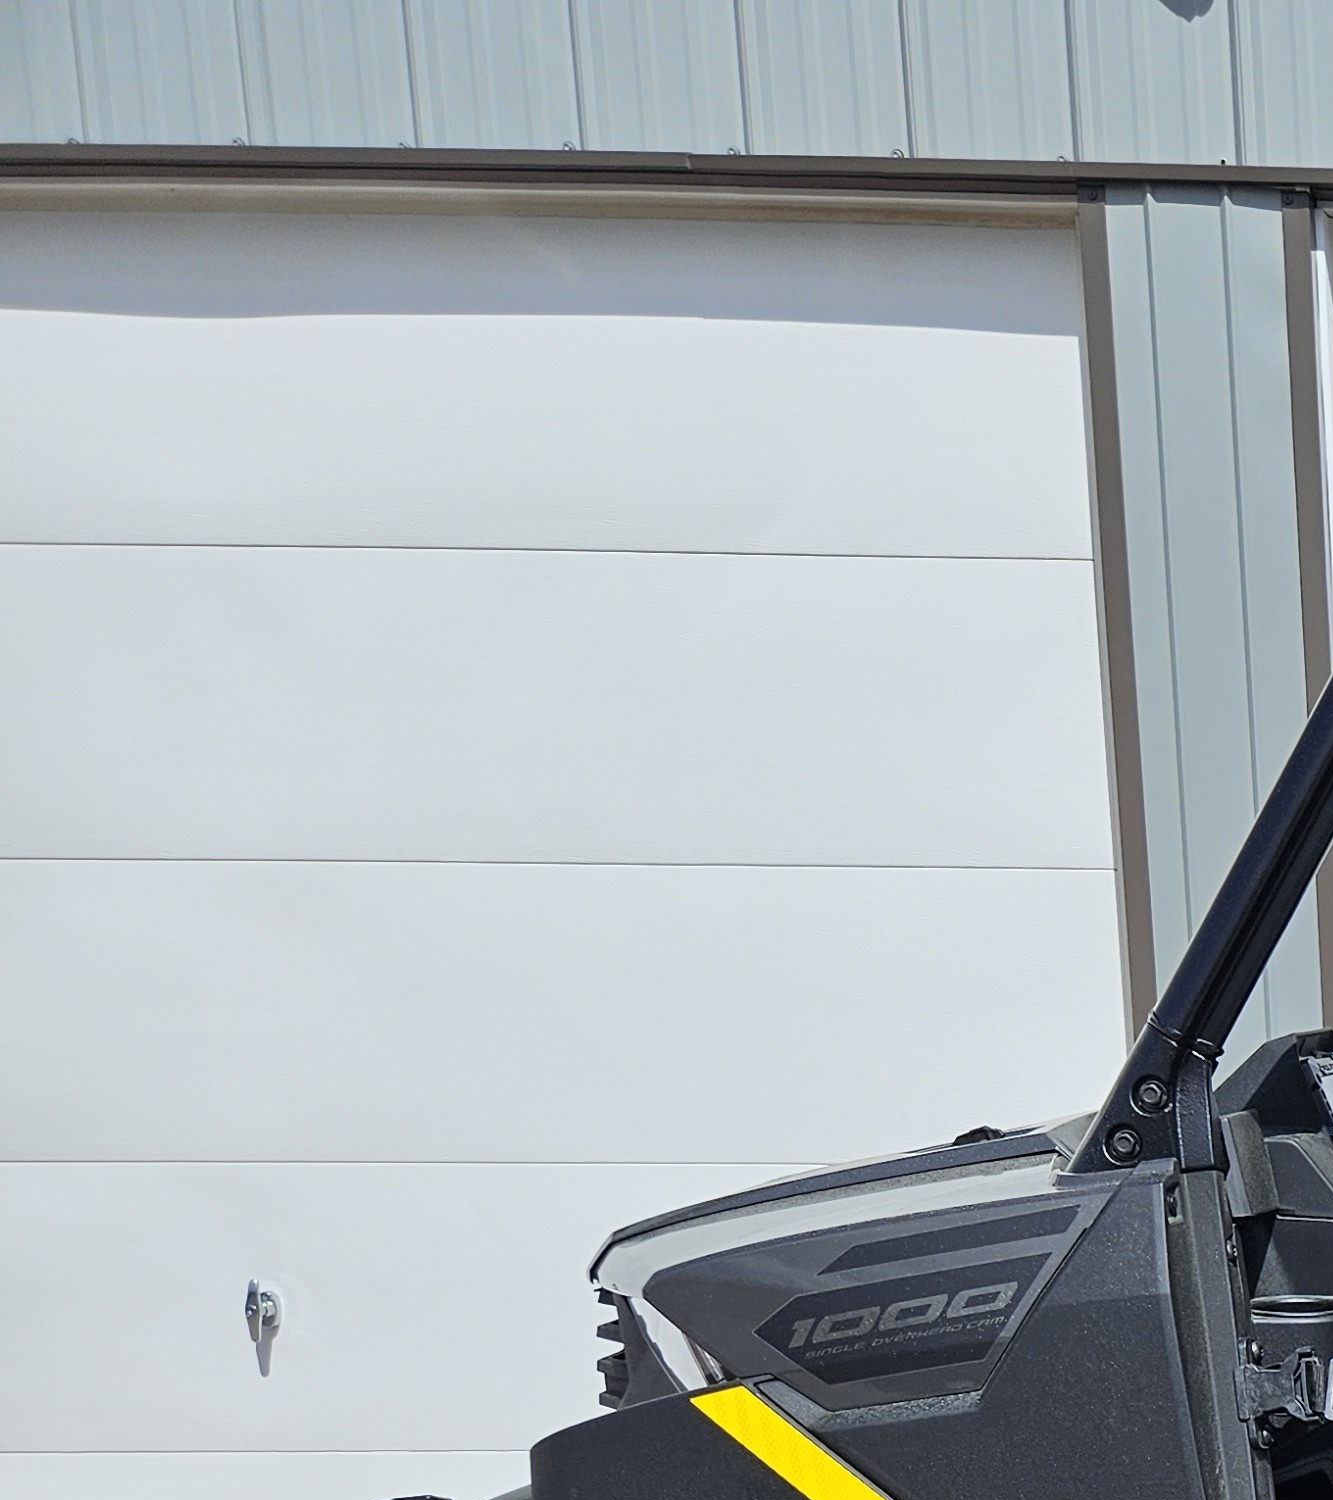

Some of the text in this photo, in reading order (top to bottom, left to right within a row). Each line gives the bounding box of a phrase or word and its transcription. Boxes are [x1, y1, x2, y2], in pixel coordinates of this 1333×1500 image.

[788, 1281, 1019, 1348] 1000
[804, 1340, 866, 1360] SINGLE
[873, 1323, 962, 1346] OVERHEAD
